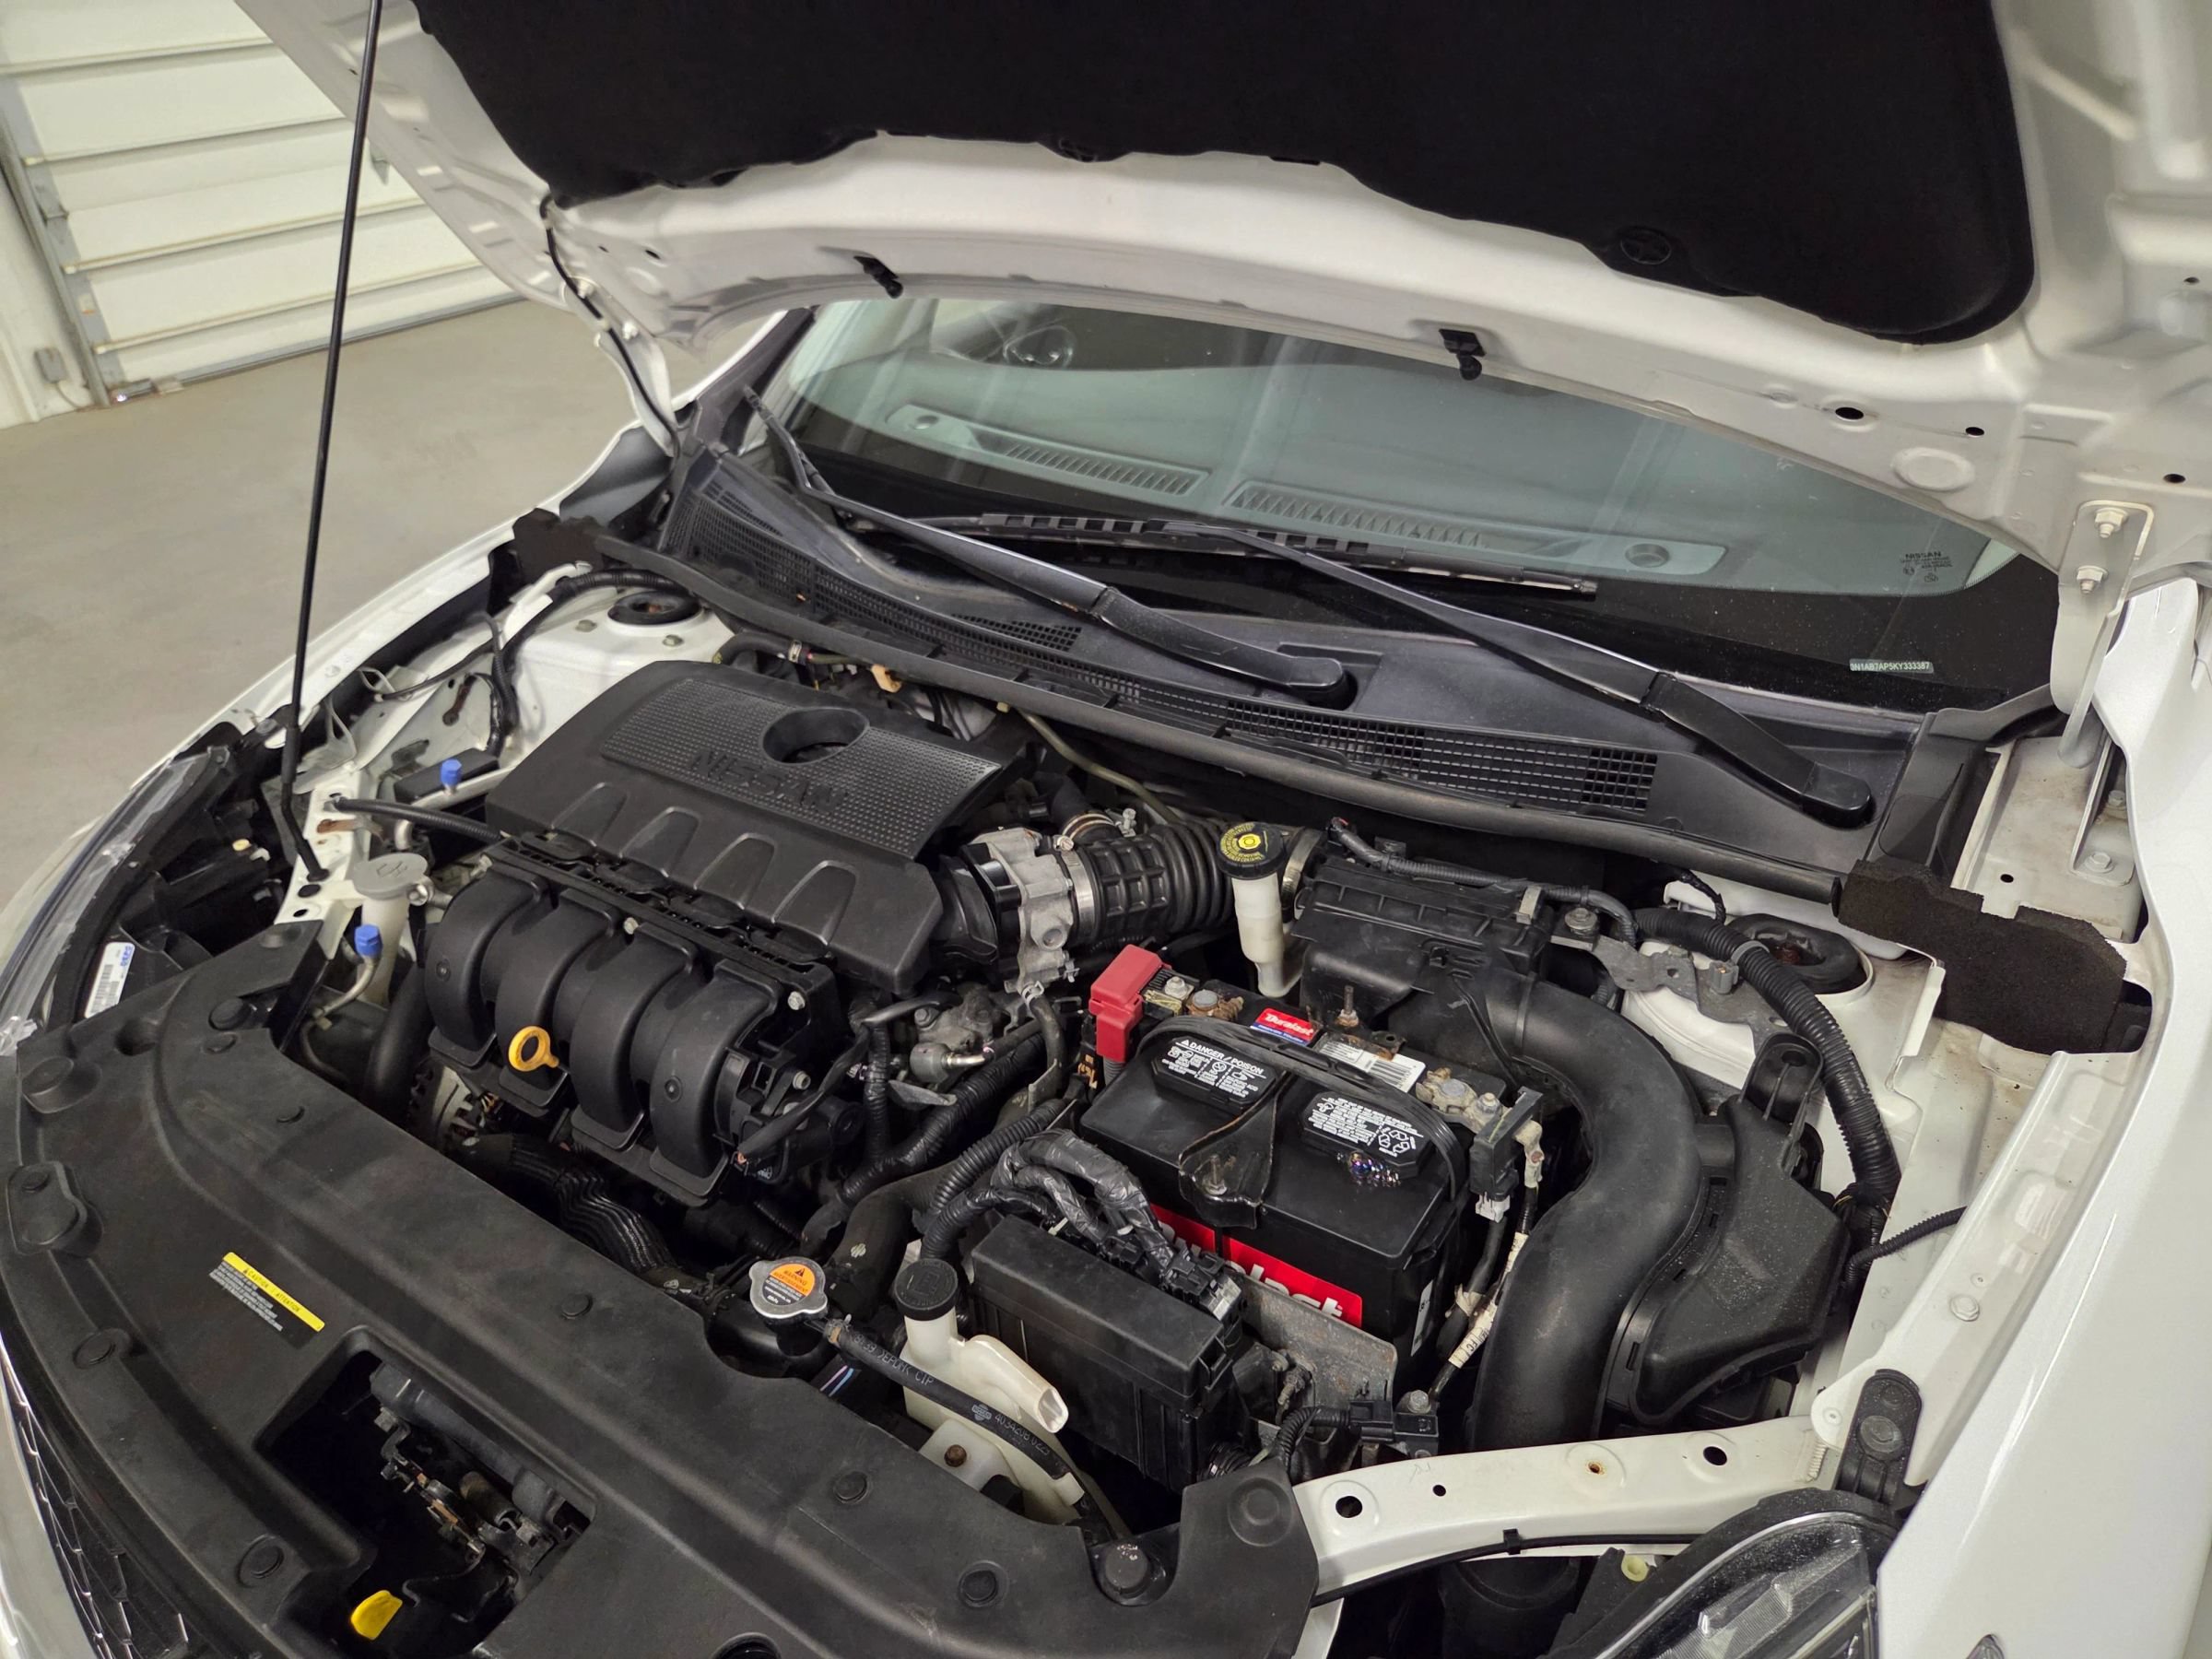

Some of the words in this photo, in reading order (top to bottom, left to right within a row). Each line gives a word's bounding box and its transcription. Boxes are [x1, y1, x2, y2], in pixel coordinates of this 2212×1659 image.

[1850, 662, 1930, 672] 3N1AB7AP5KY333387
[692, 749, 850, 810] NISSAN
[1265, 1013, 1314, 1036] Duralast
[1190, 1041, 1225, 1060] DANGER
[1230, 1058, 1265, 1075] POISON
